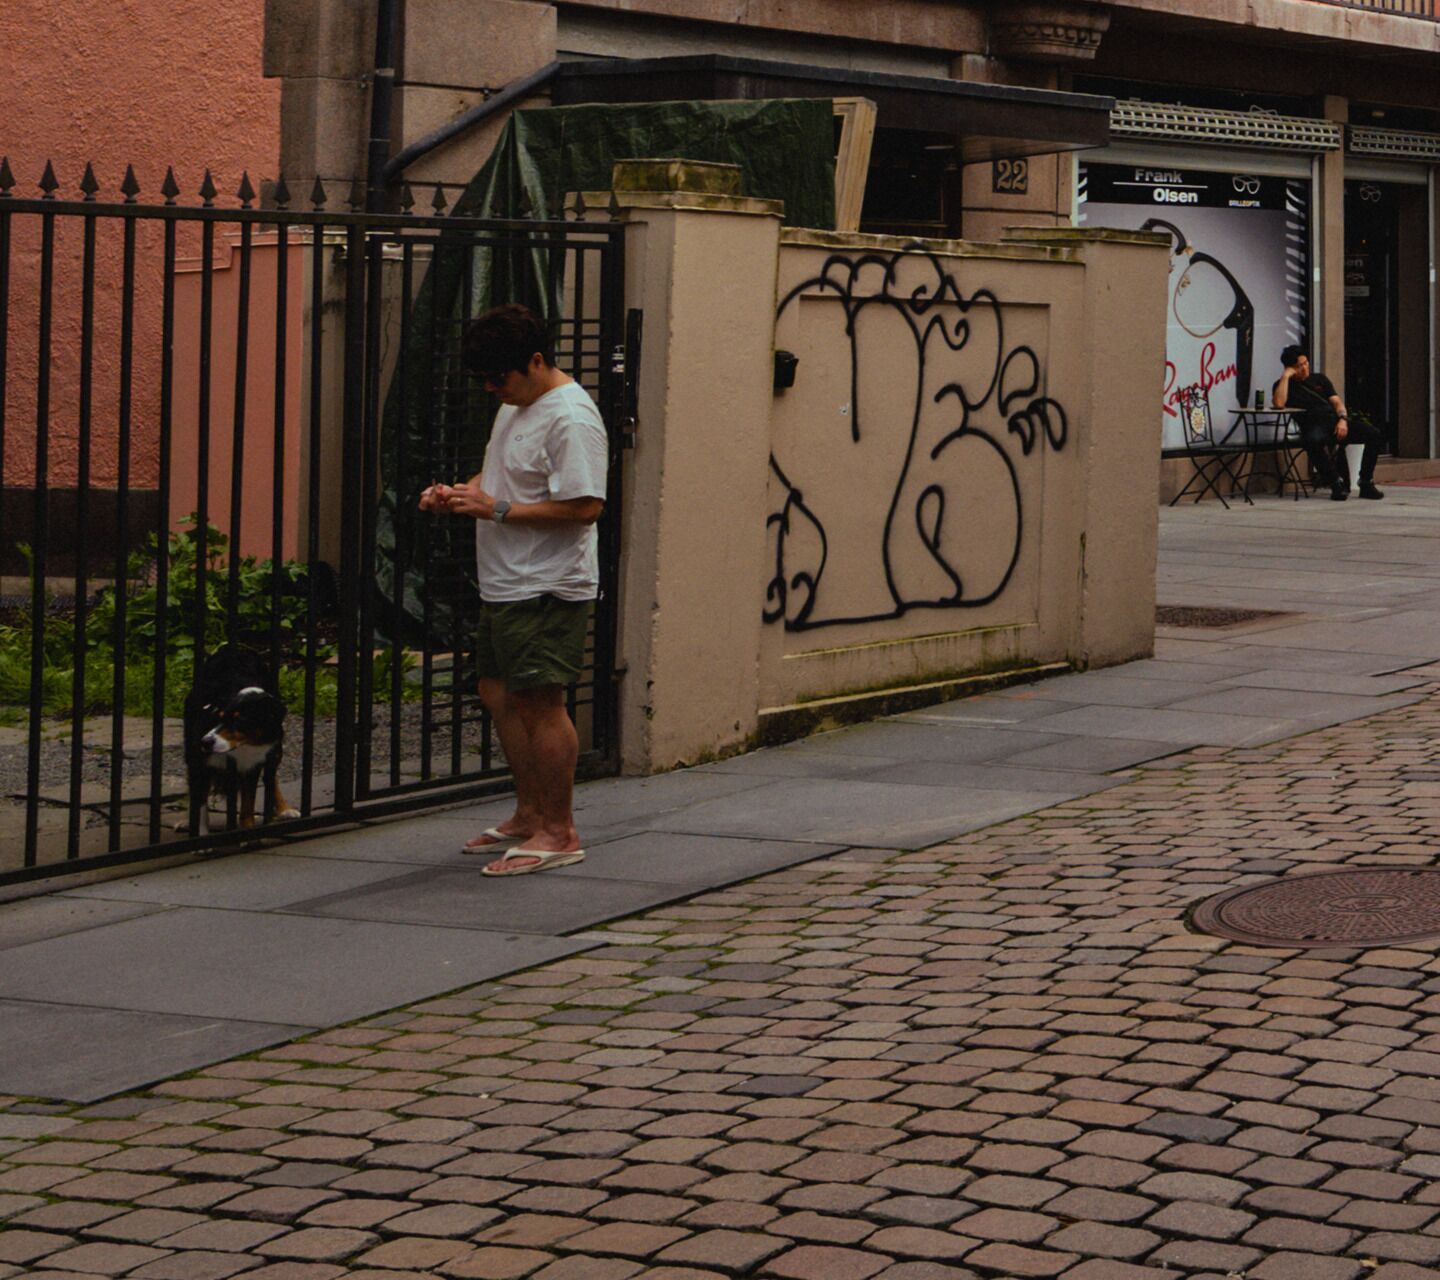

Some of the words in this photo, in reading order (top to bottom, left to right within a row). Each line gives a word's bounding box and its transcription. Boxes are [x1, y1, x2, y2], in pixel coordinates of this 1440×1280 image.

[997, 159, 1026, 190] 22
[1134, 168, 1183, 184] Frank
[1153, 188, 1198, 203] Olsen
